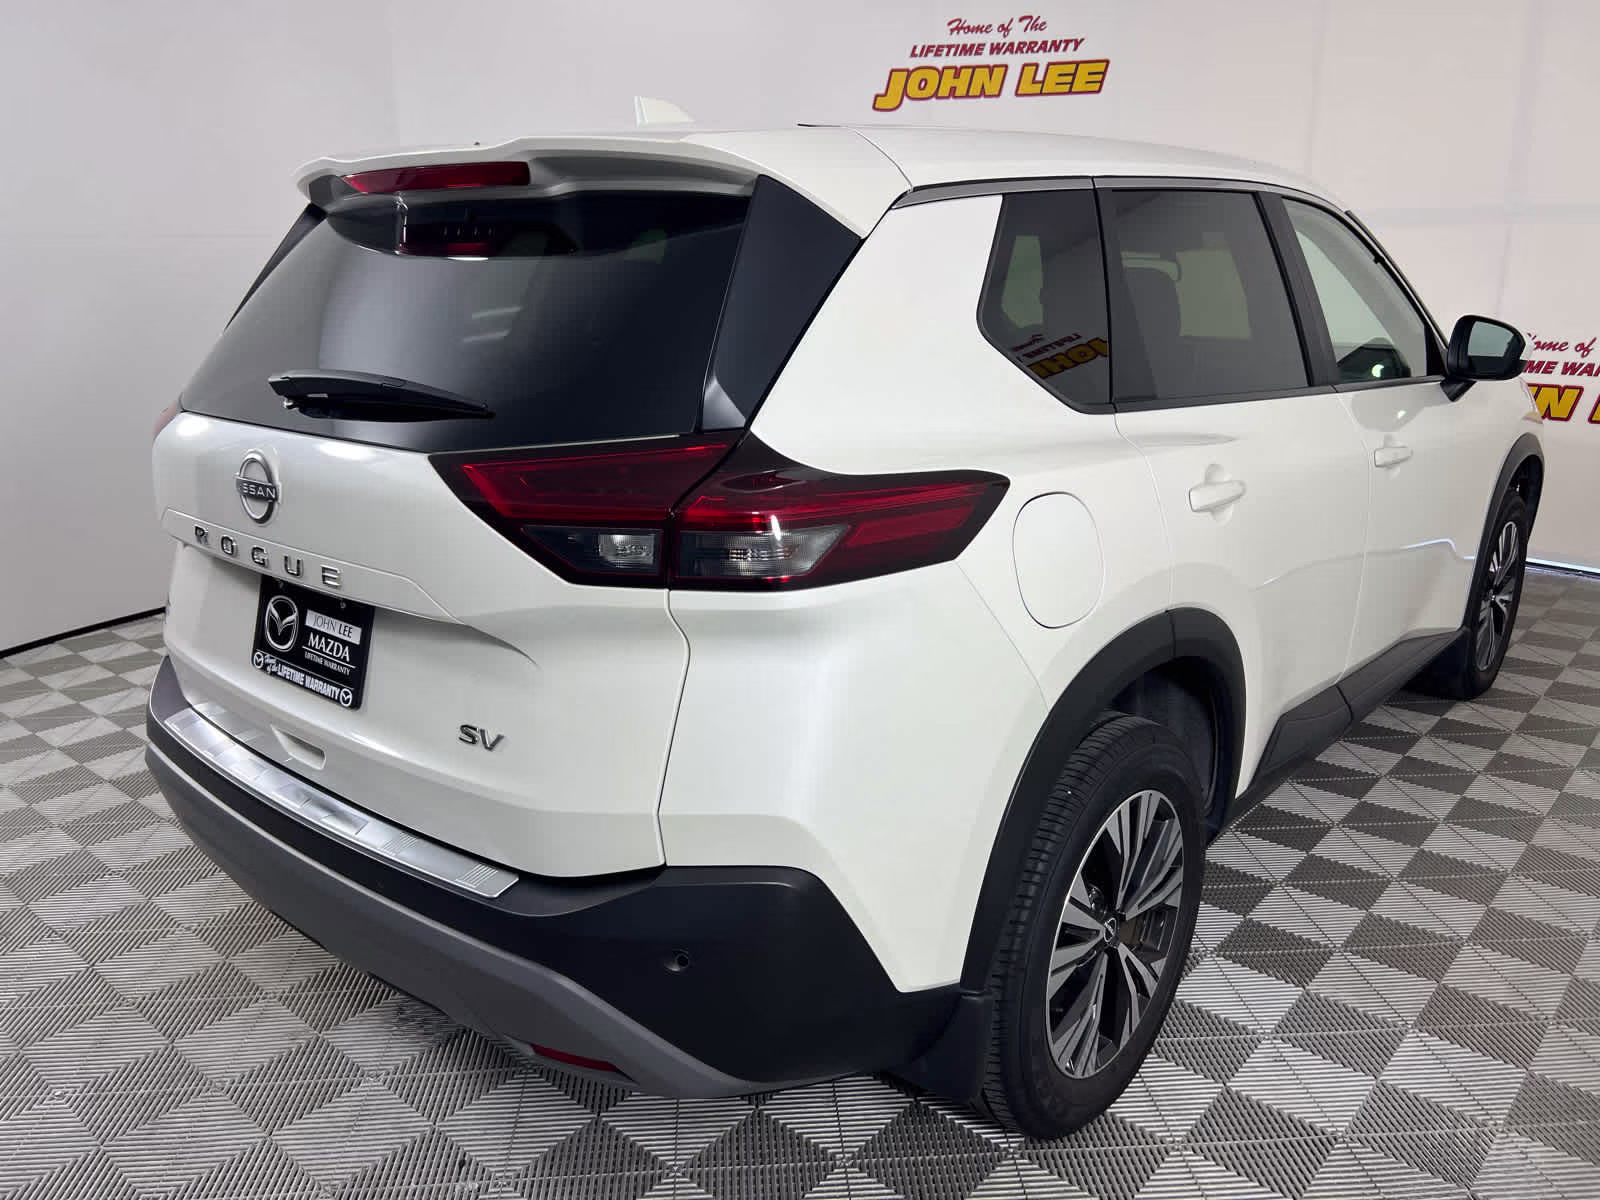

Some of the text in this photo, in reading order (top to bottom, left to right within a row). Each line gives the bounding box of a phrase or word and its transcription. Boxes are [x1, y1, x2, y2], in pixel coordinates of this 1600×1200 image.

[947, 15, 1048, 38] Home of The
[910, 38, 1085, 58] LIFETIME WARRANTY
[872, 59, 1110, 112] JOHN LEE
[1575, 337, 1597, 358] of
[194, 525, 342, 588] ROGUE
[313, 616, 353, 639] JOHN LEE
[307, 631, 350, 662] MAZDA
[277, 663, 305, 686] LIFETIME
[304, 674, 341, 700] WARRANTY
[459, 724, 505, 751] SV
